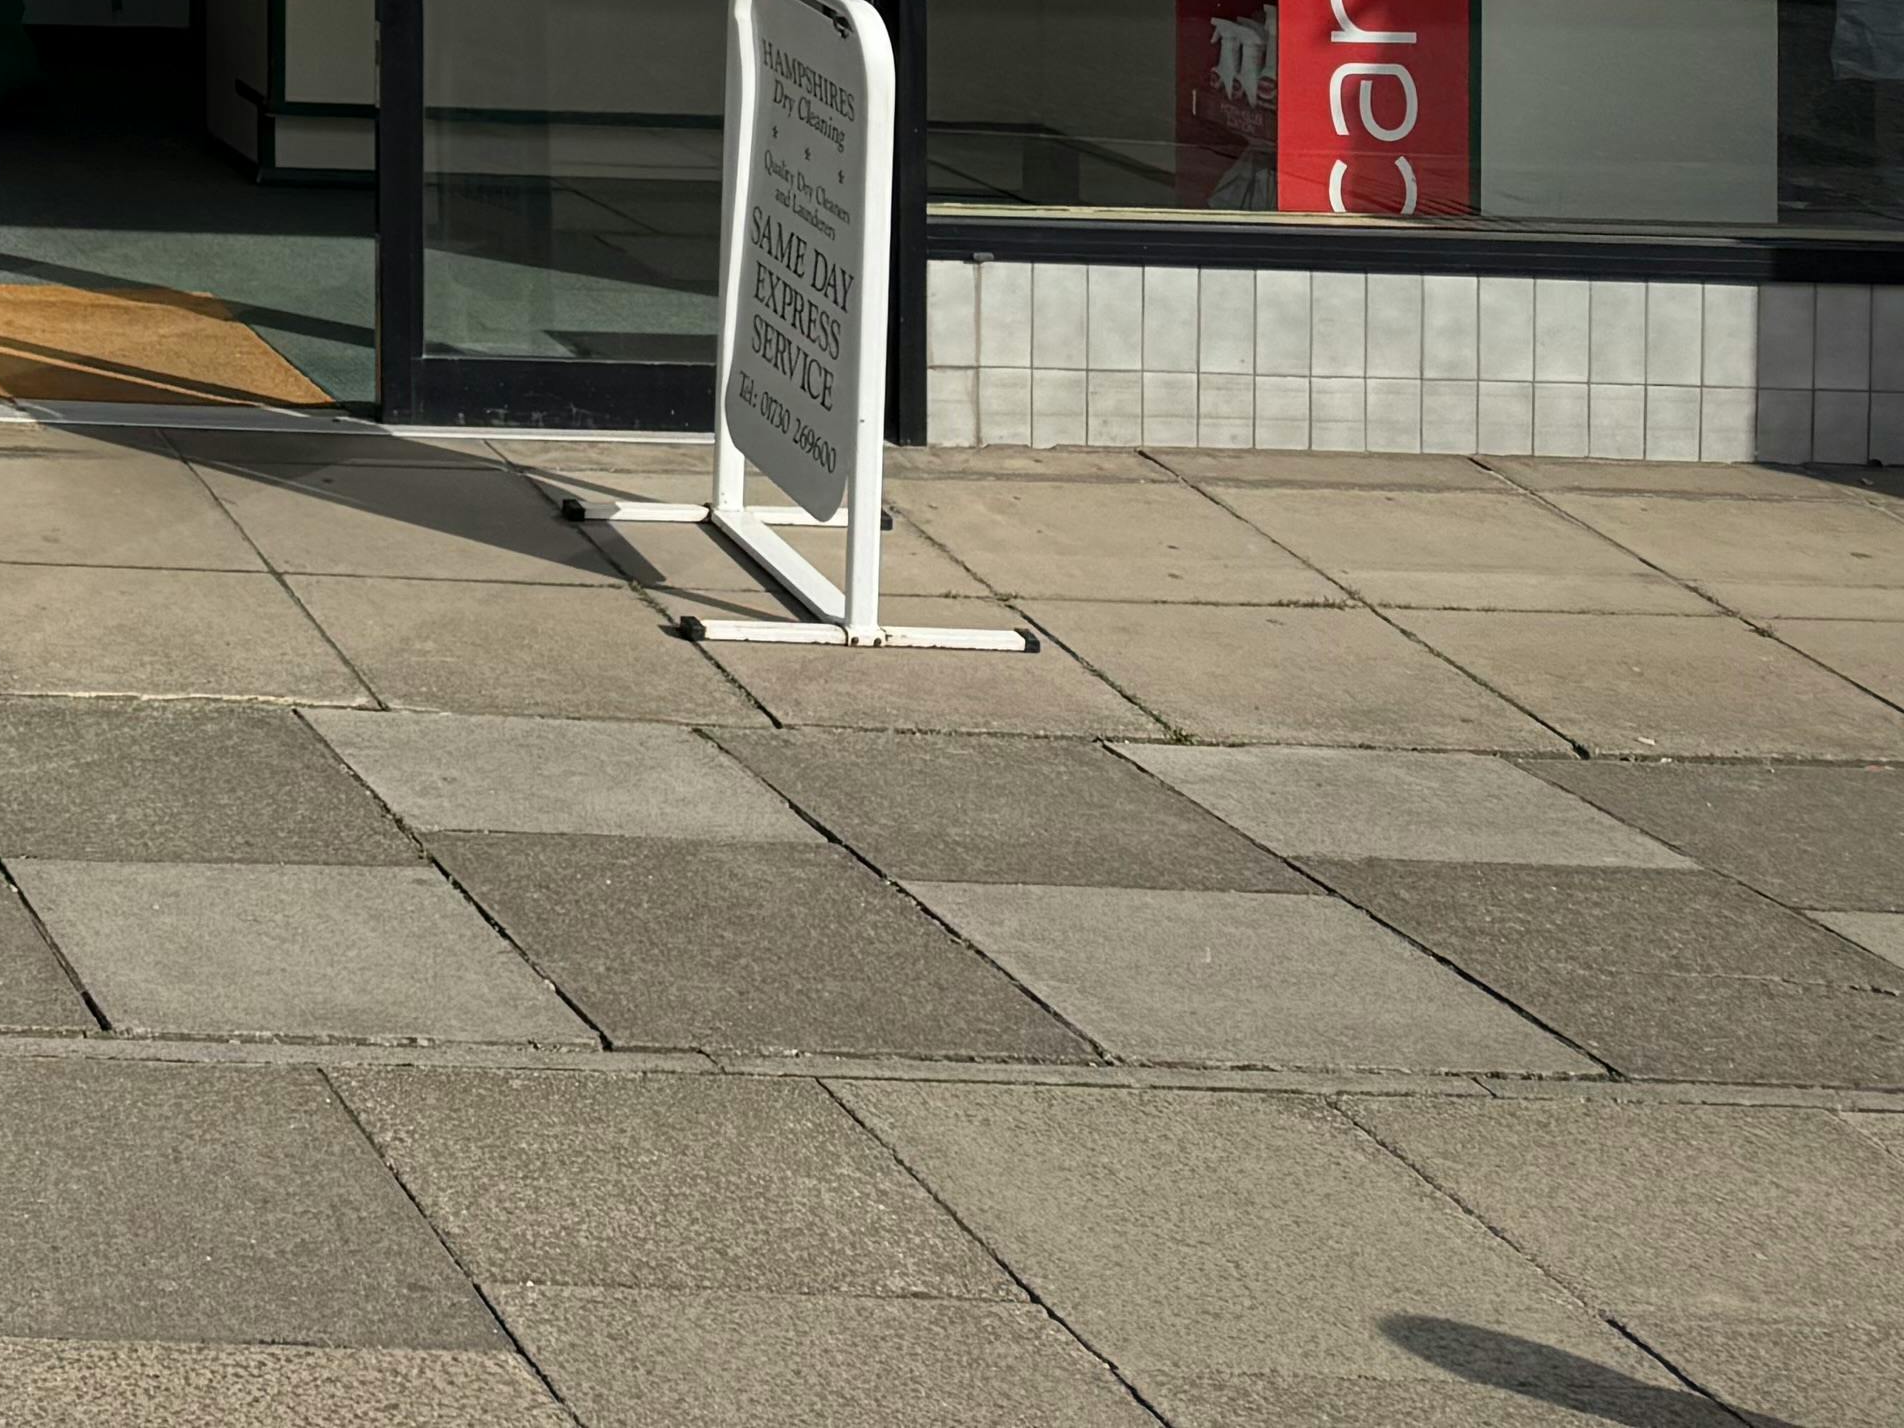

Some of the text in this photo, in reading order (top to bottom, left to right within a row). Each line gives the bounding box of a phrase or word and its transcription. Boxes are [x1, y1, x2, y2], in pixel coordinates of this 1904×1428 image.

[762, 39, 855, 123] HAMPSHIRES
[773, 79, 846, 154] Dry Cleaning
[764, 149, 851, 225] Quality Dry Cleaners
[775, 188, 792, 209] and
[750, 205, 854, 313] SAME DAY
[754, 260, 841, 361] EXPRESS
[751, 313, 835, 412] SERVICE
[739, 370, 837, 475] Tel: 01730 269600
